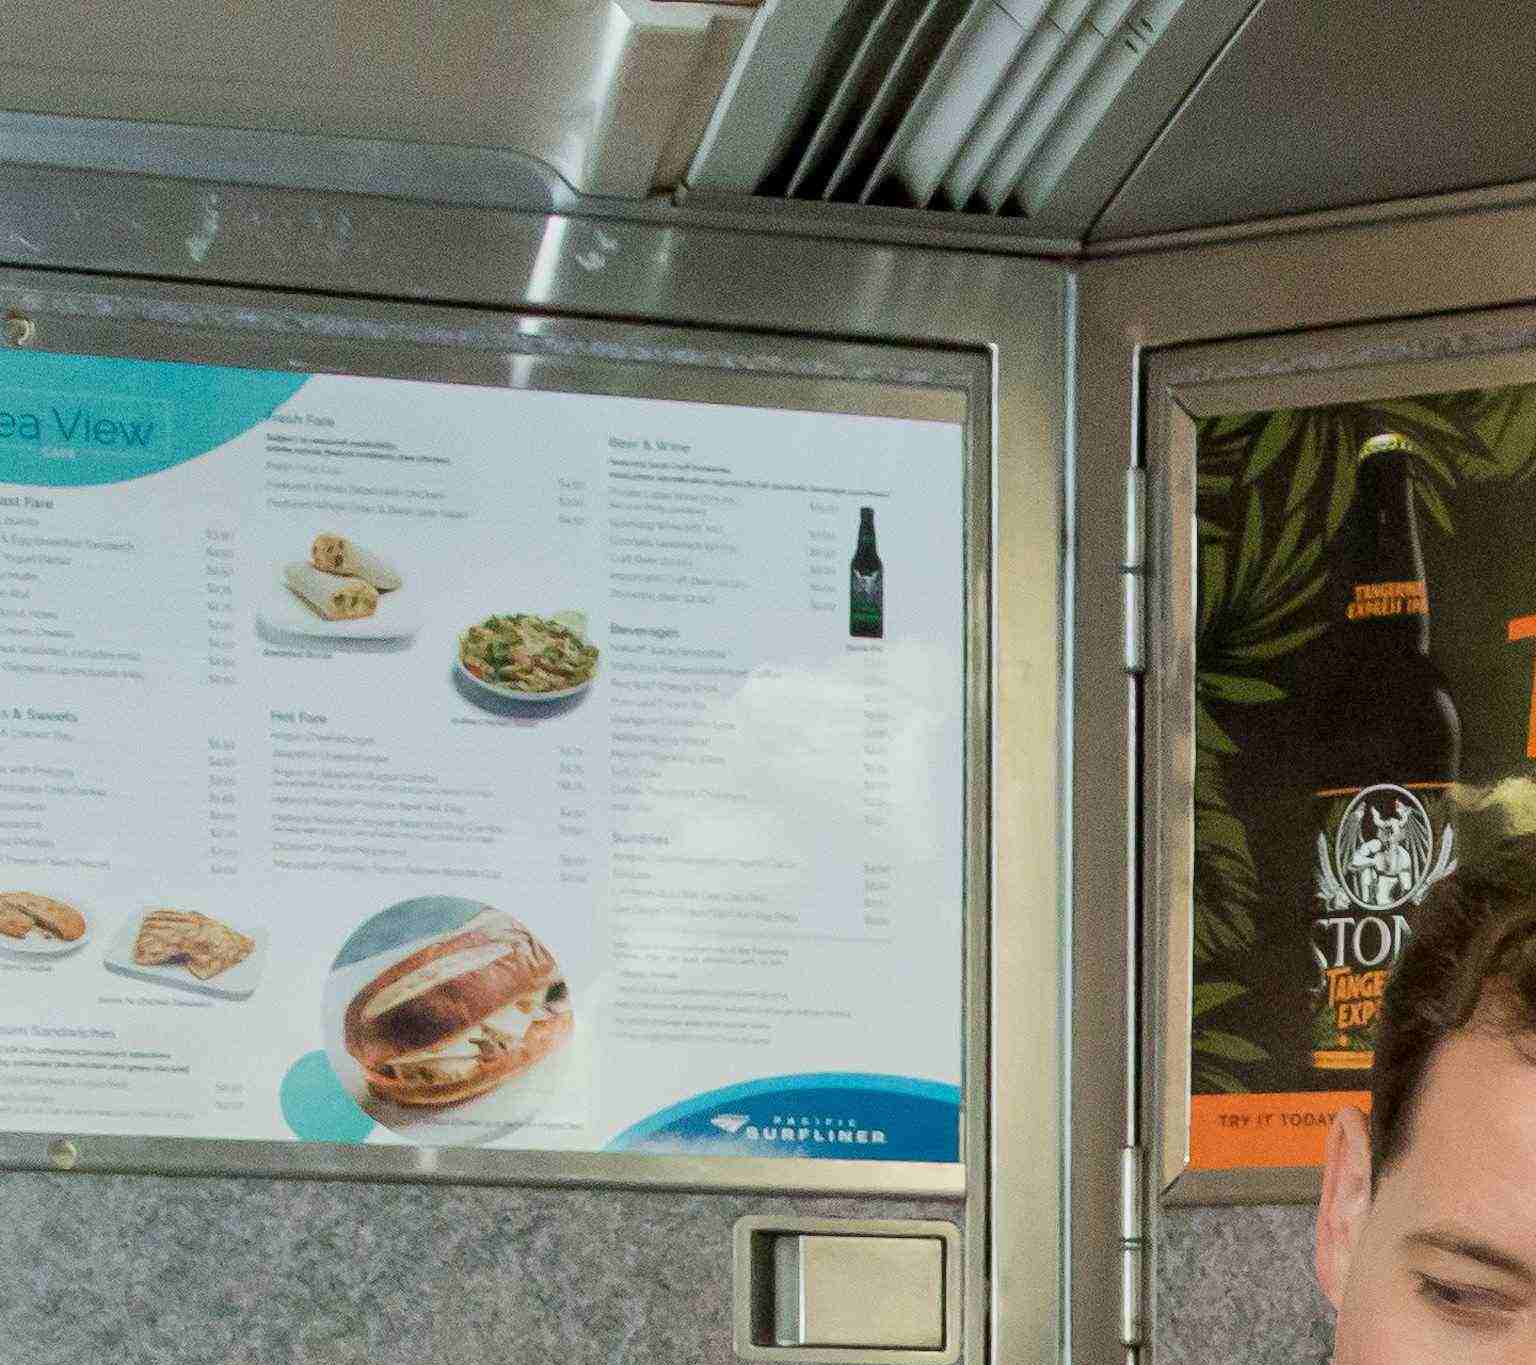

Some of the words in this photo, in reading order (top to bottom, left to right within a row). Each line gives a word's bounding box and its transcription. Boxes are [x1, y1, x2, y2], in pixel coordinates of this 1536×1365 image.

[51, 408, 155, 450] View
[1218, 1114, 1250, 1128] TRY
[1256, 1114, 1273, 1125] IT
[1280, 1112, 1338, 1128] TODAY
[746, 1125, 888, 1146] SURFLINER
